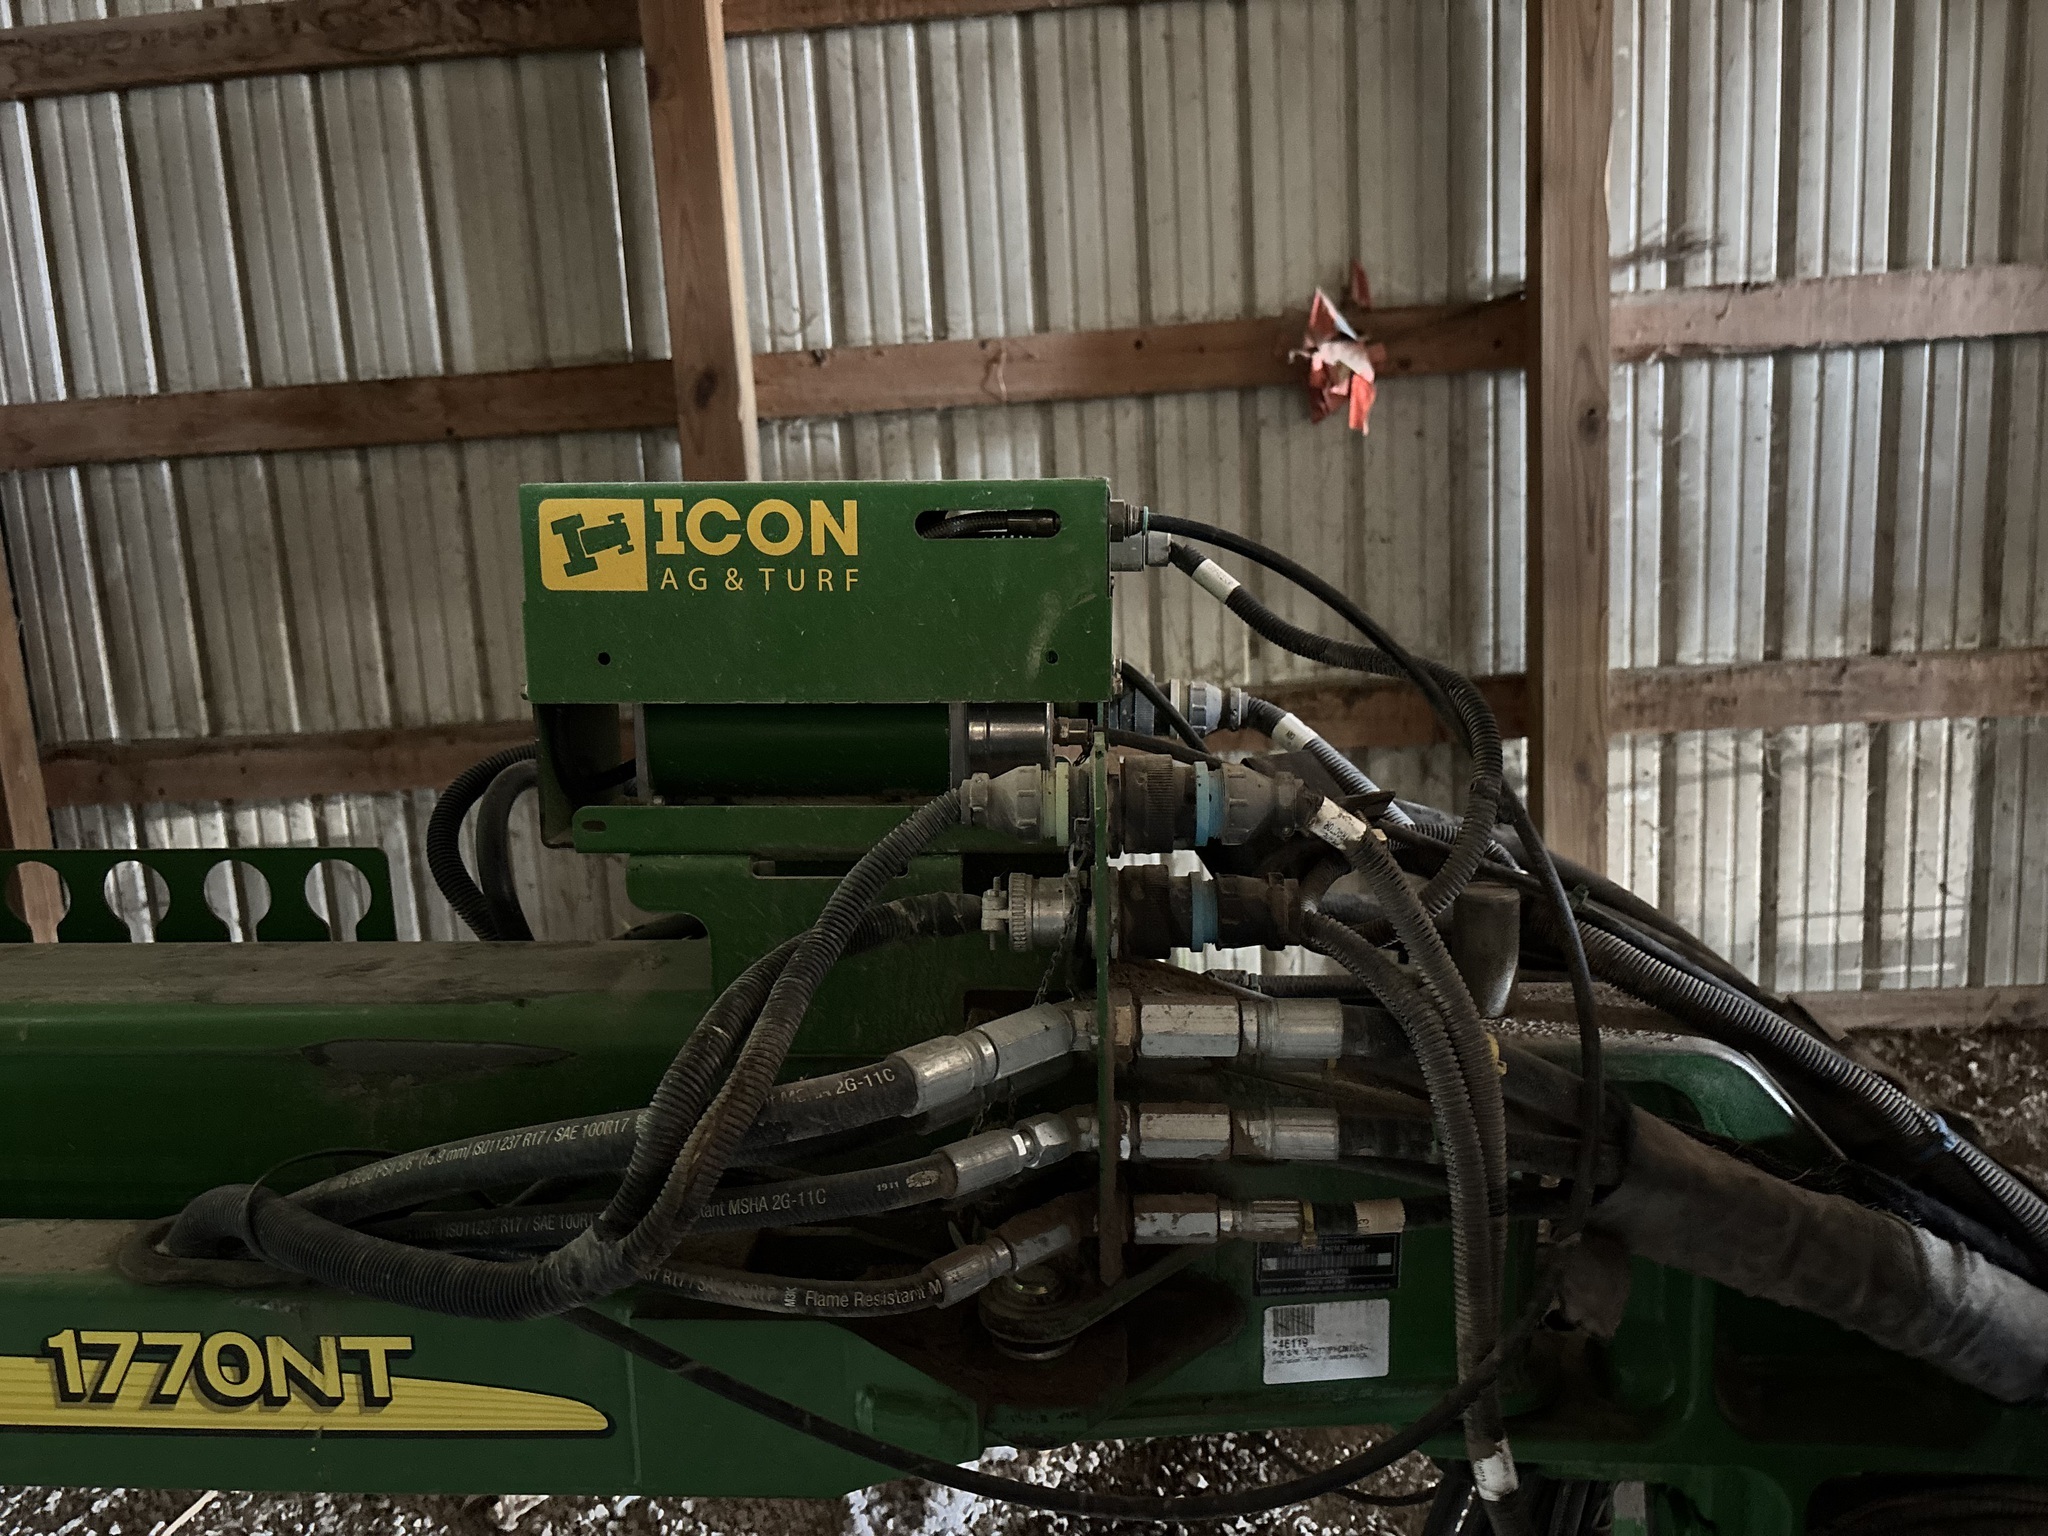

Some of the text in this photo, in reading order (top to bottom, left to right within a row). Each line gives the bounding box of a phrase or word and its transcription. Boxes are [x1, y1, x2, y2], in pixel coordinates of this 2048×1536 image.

[653, 498, 859, 556] ICON
[660, 567, 859, 592] AG & TURF
[836, 1068, 896, 1095] 2G-11C
[522, 1130, 546, 1147] R17
[554, 1125, 580, 1142] SAE
[582, 1117, 631, 1138] 100R17
[728, 1196, 769, 1216] MSHA
[772, 1188, 827, 1211] 2G-11C
[500, 1215, 523, 1233] R17
[533, 1214, 556, 1232] SAE
[560, 1211, 600, 1230] 100R1
[805, 1289, 849, 1308] Flame
[853, 1283, 926, 1308] Resistant
[47, 1328, 414, 1408] 1770NT
